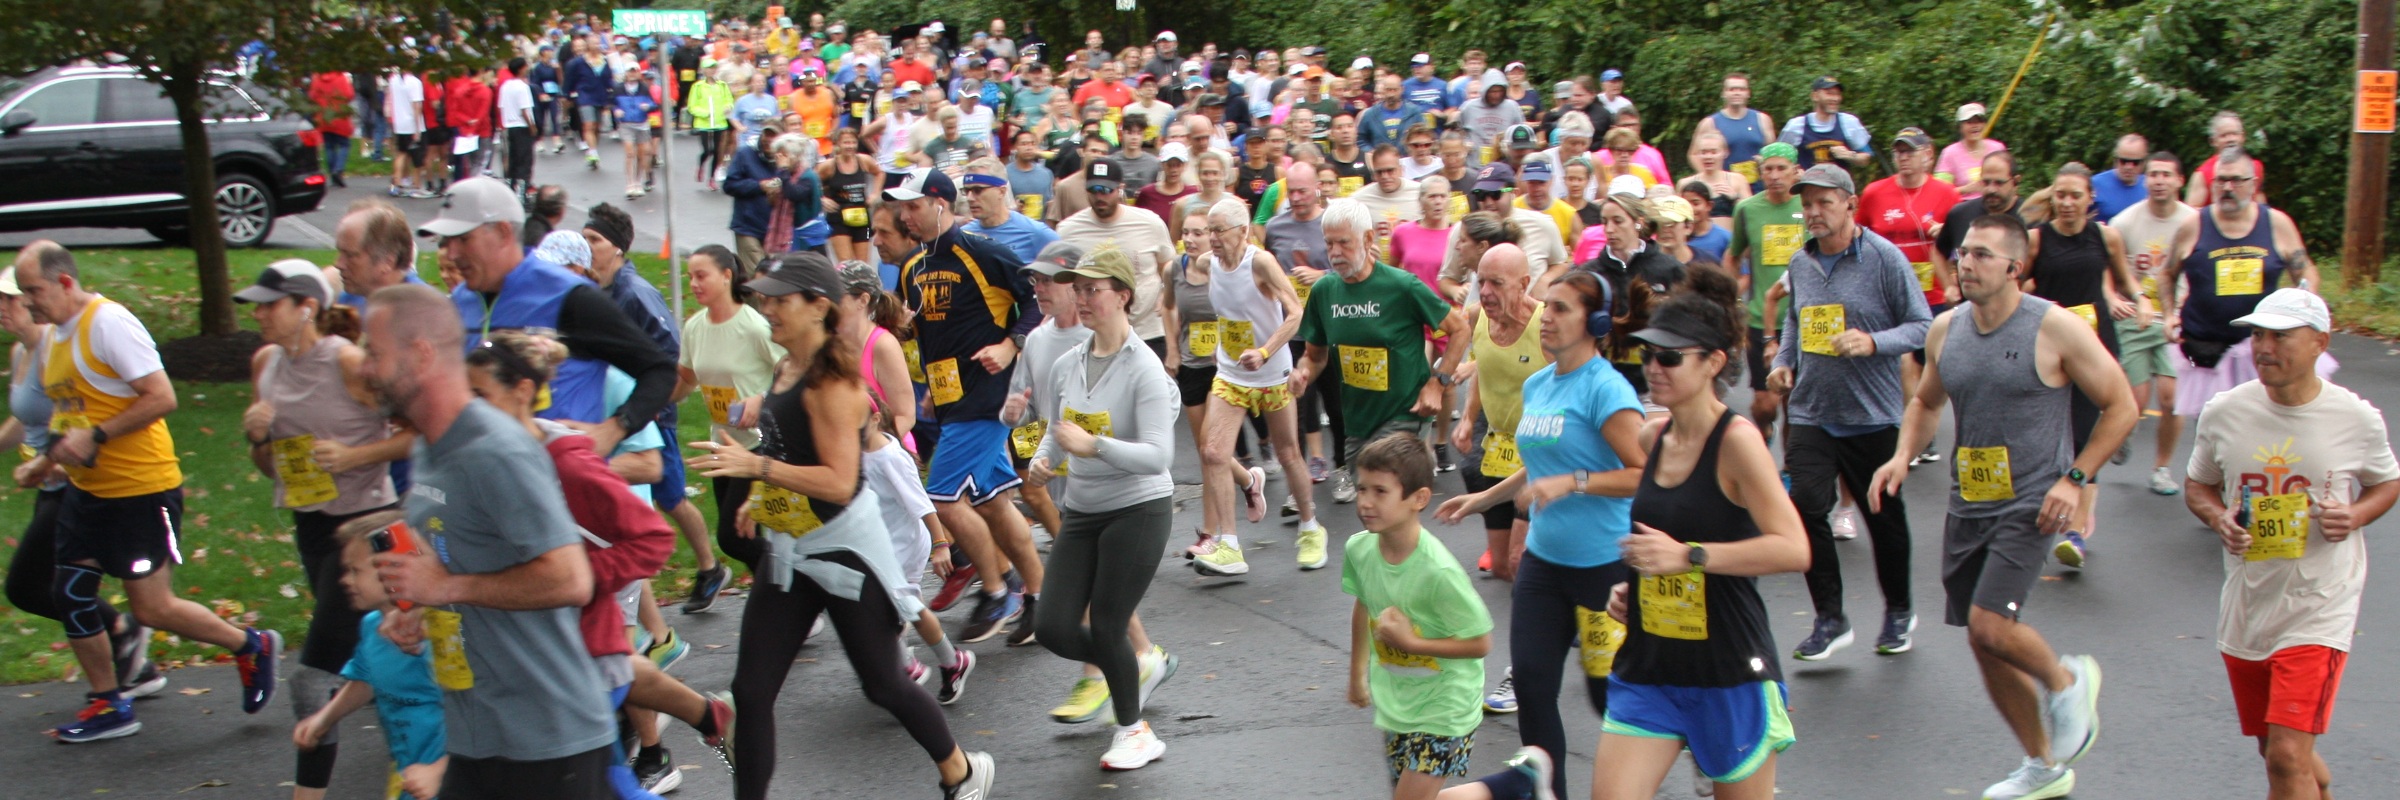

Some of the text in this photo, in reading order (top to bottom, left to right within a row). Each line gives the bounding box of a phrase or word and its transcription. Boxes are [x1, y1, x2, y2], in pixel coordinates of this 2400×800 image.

[622, 13, 690, 32] SPRUCE
[939, 270, 962, 284] TOWNS
[1331, 300, 1380, 319] TACONIC
[1811, 321, 1828, 335] 596
[1201, 333, 1216, 344] 470
[1353, 362, 1371, 375] 837
[1027, 435, 1039, 447] 85
[1496, 447, 1514, 461] 740
[1971, 467, 1991, 482] 491
[765, 497, 790, 516] 909
[2259, 499, 2281, 511] BTC
[2258, 518, 2284, 538] 581
[1659, 575, 1683, 598] 616
[1588, 630, 1609, 645] 452
